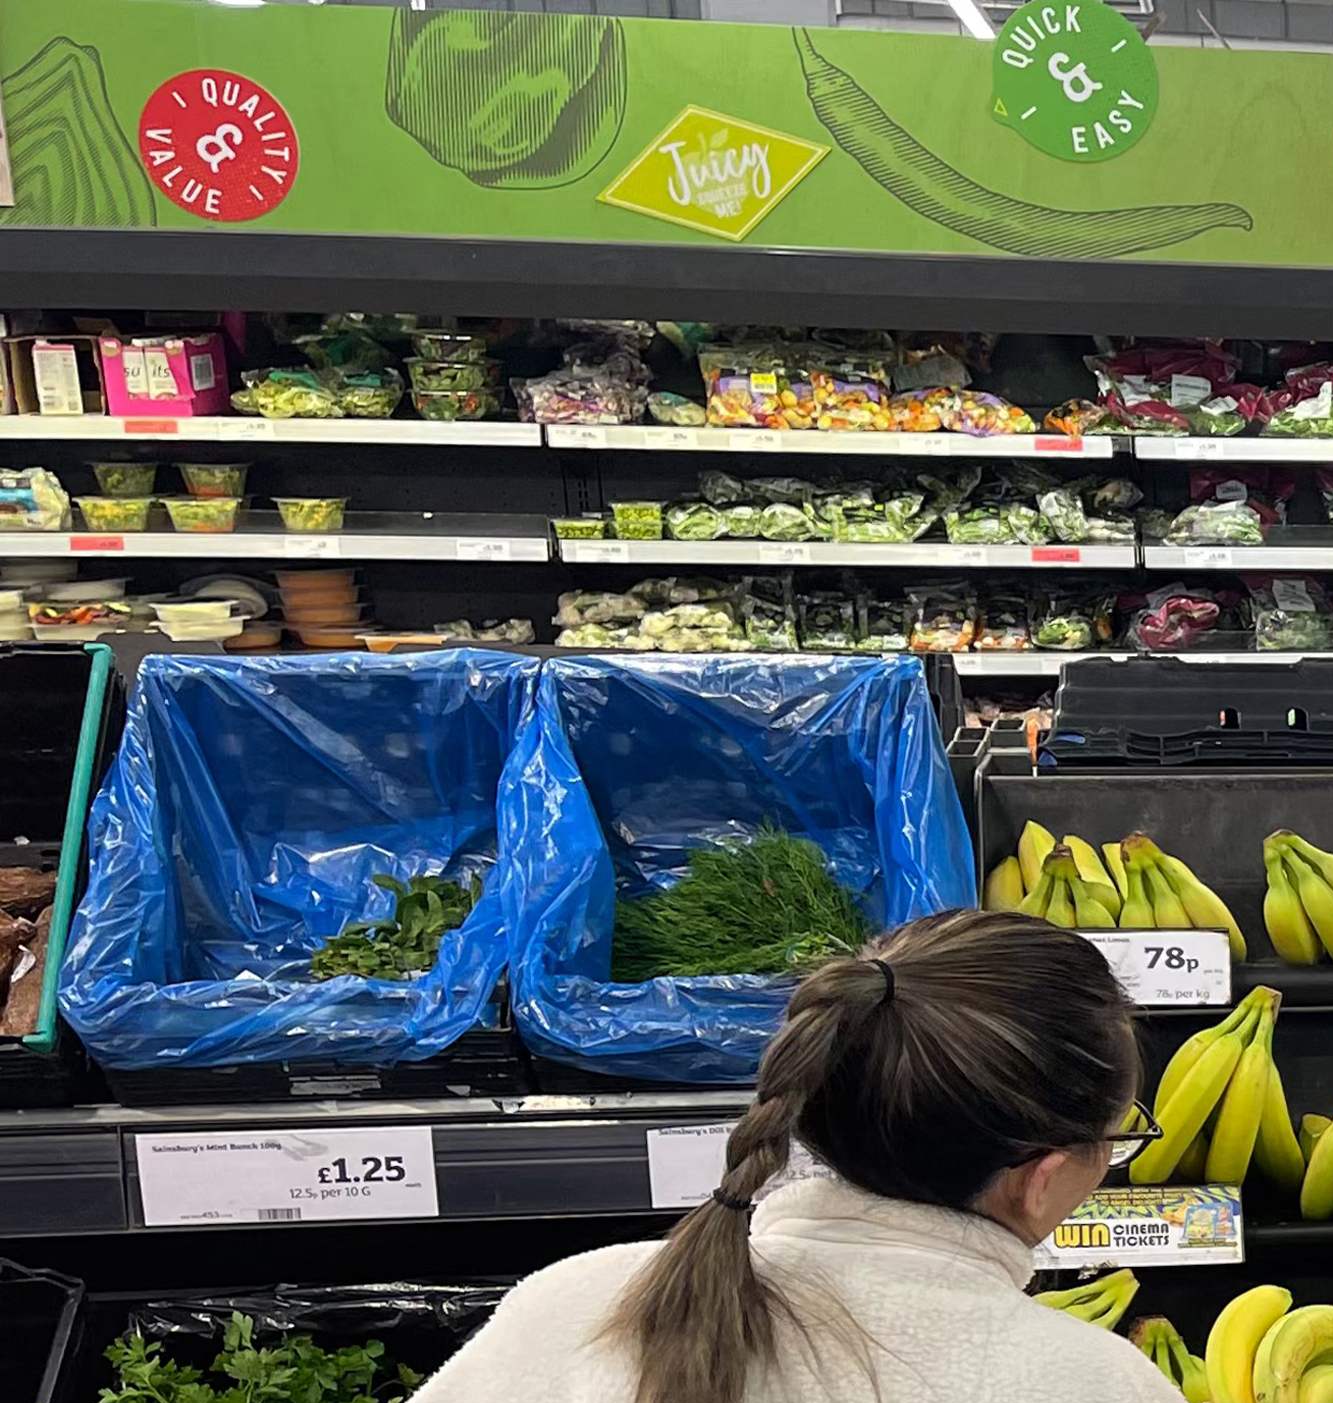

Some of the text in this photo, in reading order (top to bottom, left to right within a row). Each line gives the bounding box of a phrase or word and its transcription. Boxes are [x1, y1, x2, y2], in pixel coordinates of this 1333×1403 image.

[1002, 5, 1081, 69] QUICK
[1048, 52, 1103, 102] &
[201, 78, 290, 185] QUALITY
[1071, 90, 1144, 153] EASY
[145, 128, 223, 214] VALUE
[196, 123, 243, 174] &
[659, 141, 771, 206] Juicy
[1144, 947, 1199, 973] 78p
[318, 1156, 406, 1183] £1.25
[320, 1188, 342, 1198] per
[345, 1186, 358, 1197] 10
[361, 1186, 371, 1197] G
[1054, 1223, 1169, 1248] WIN CINEMA
[1113, 1236, 1169, 1248] TICKETS
